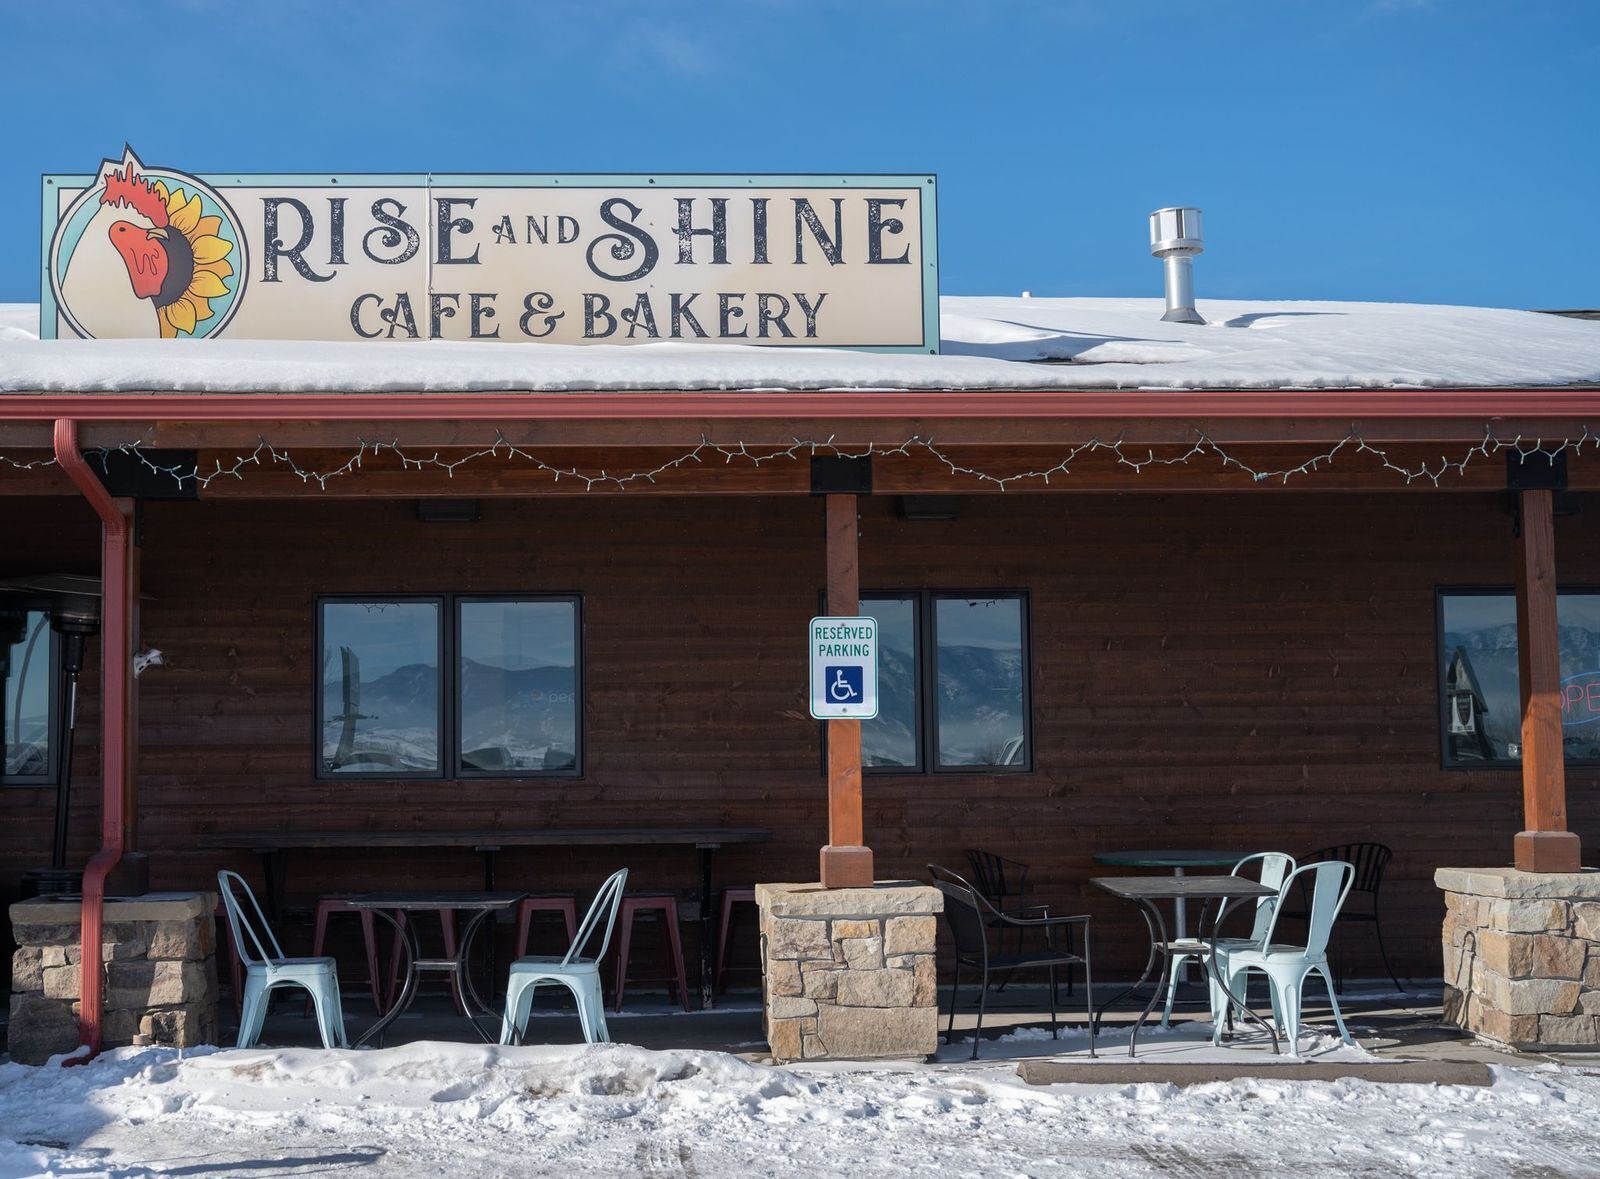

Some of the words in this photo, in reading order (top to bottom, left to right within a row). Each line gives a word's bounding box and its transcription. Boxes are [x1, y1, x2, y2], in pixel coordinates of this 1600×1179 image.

[260, 197, 481, 282] RISE
[492, 215, 580, 244] AND
[586, 197, 912, 282] SHINE
[350, 291, 501, 338] CAFE
[519, 291, 565, 337] &
[582, 291, 829, 338] BAKERY
[815, 626, 873, 640] RESERVED
[819, 644, 870, 657] PARKING
[1560, 683, 1600, 712] PE
